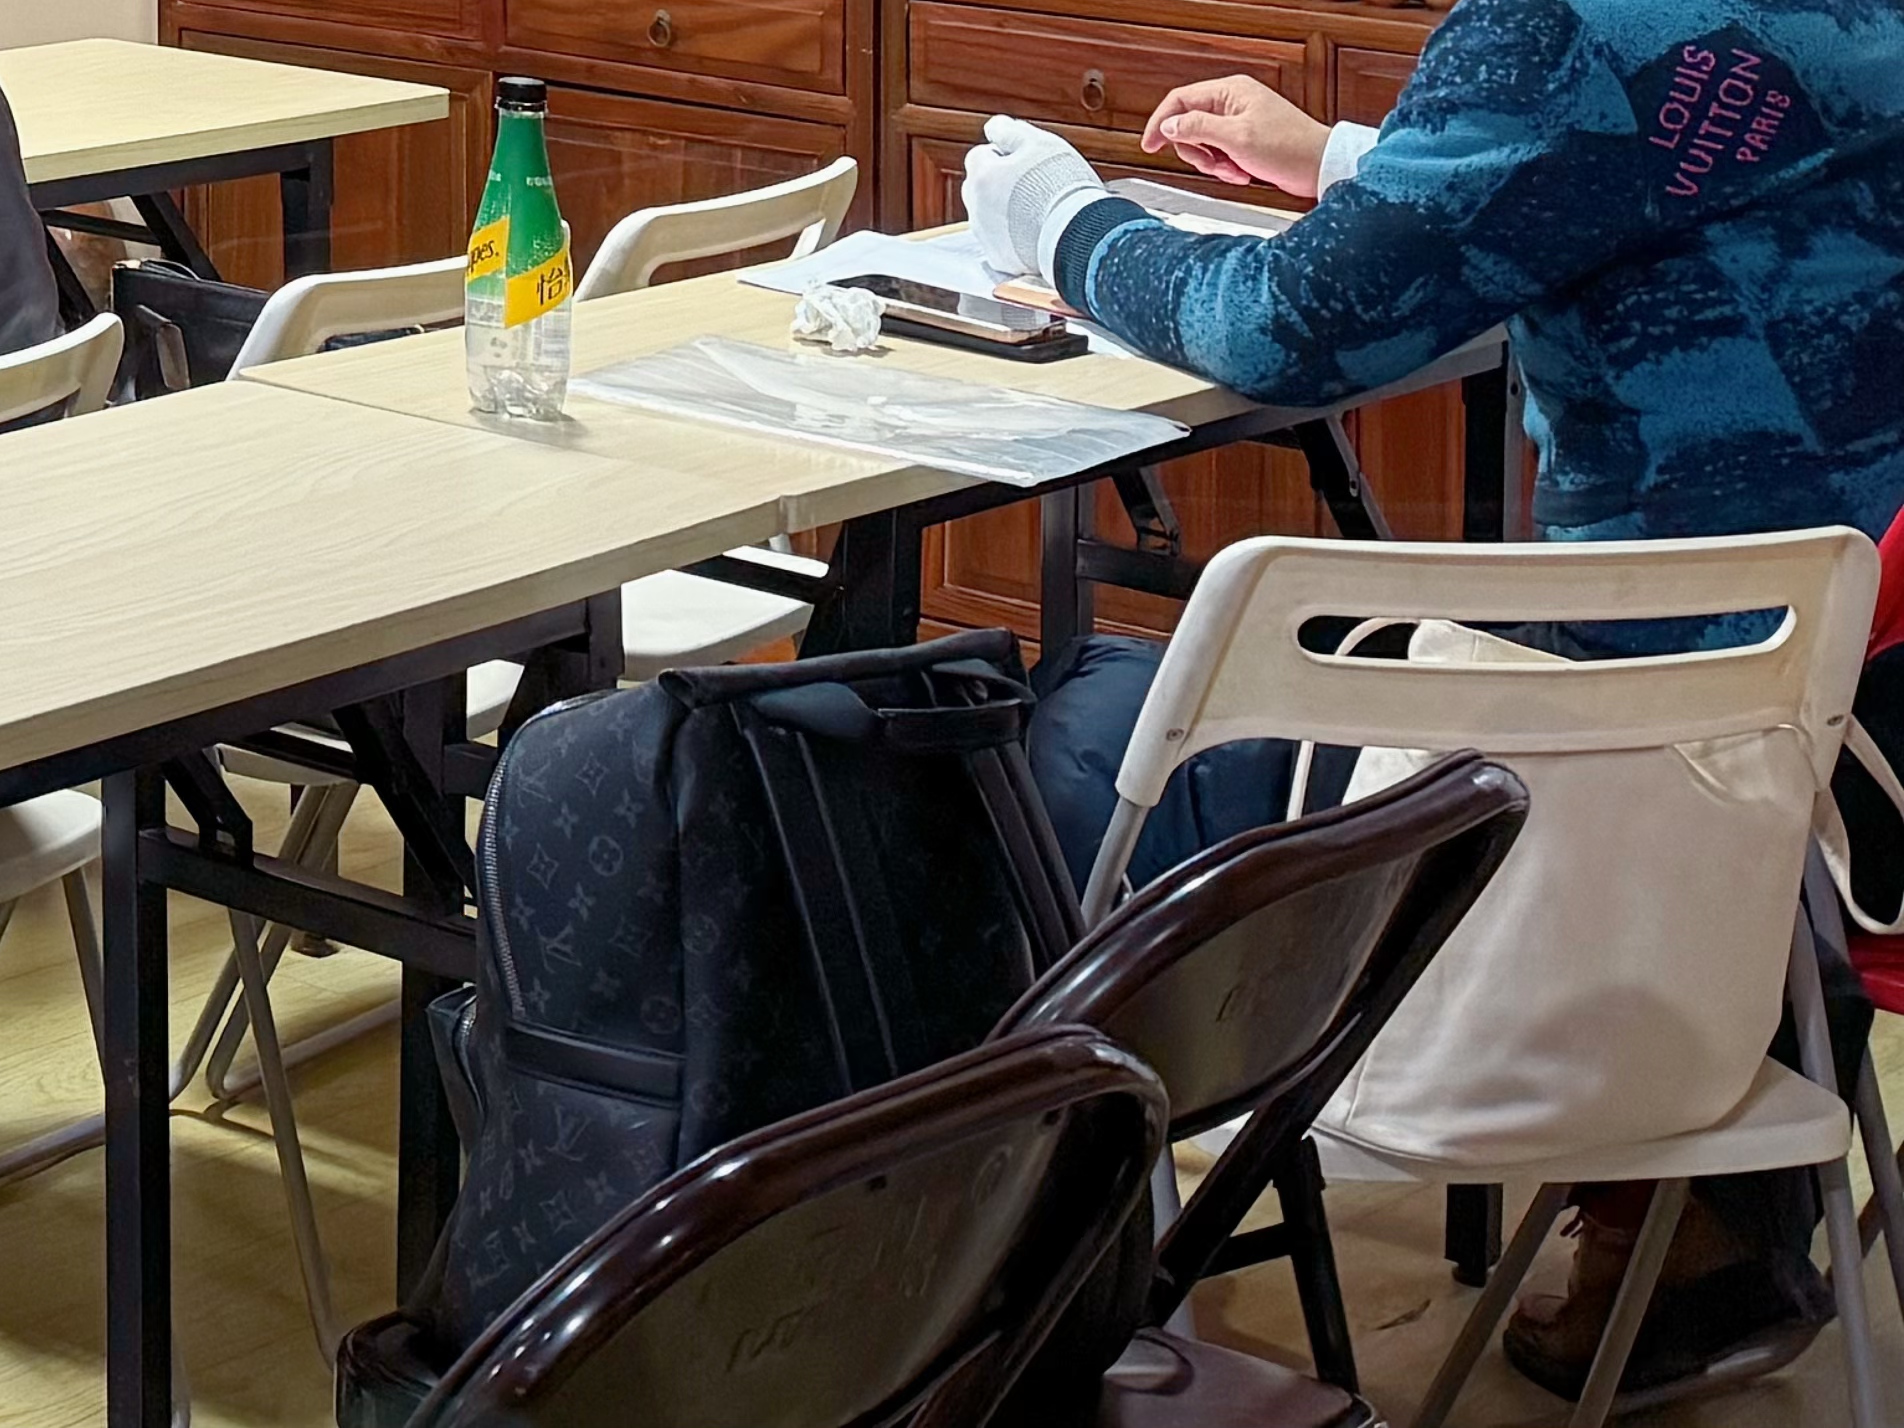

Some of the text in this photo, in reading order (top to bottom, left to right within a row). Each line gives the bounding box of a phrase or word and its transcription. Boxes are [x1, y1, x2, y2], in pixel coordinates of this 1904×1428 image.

[1648, 46, 1717, 150] LOUIS
[1665, 47, 1763, 197] VUITTON
[1735, 90, 1792, 163] PARIS
[536, 256, 570, 306] 怡
